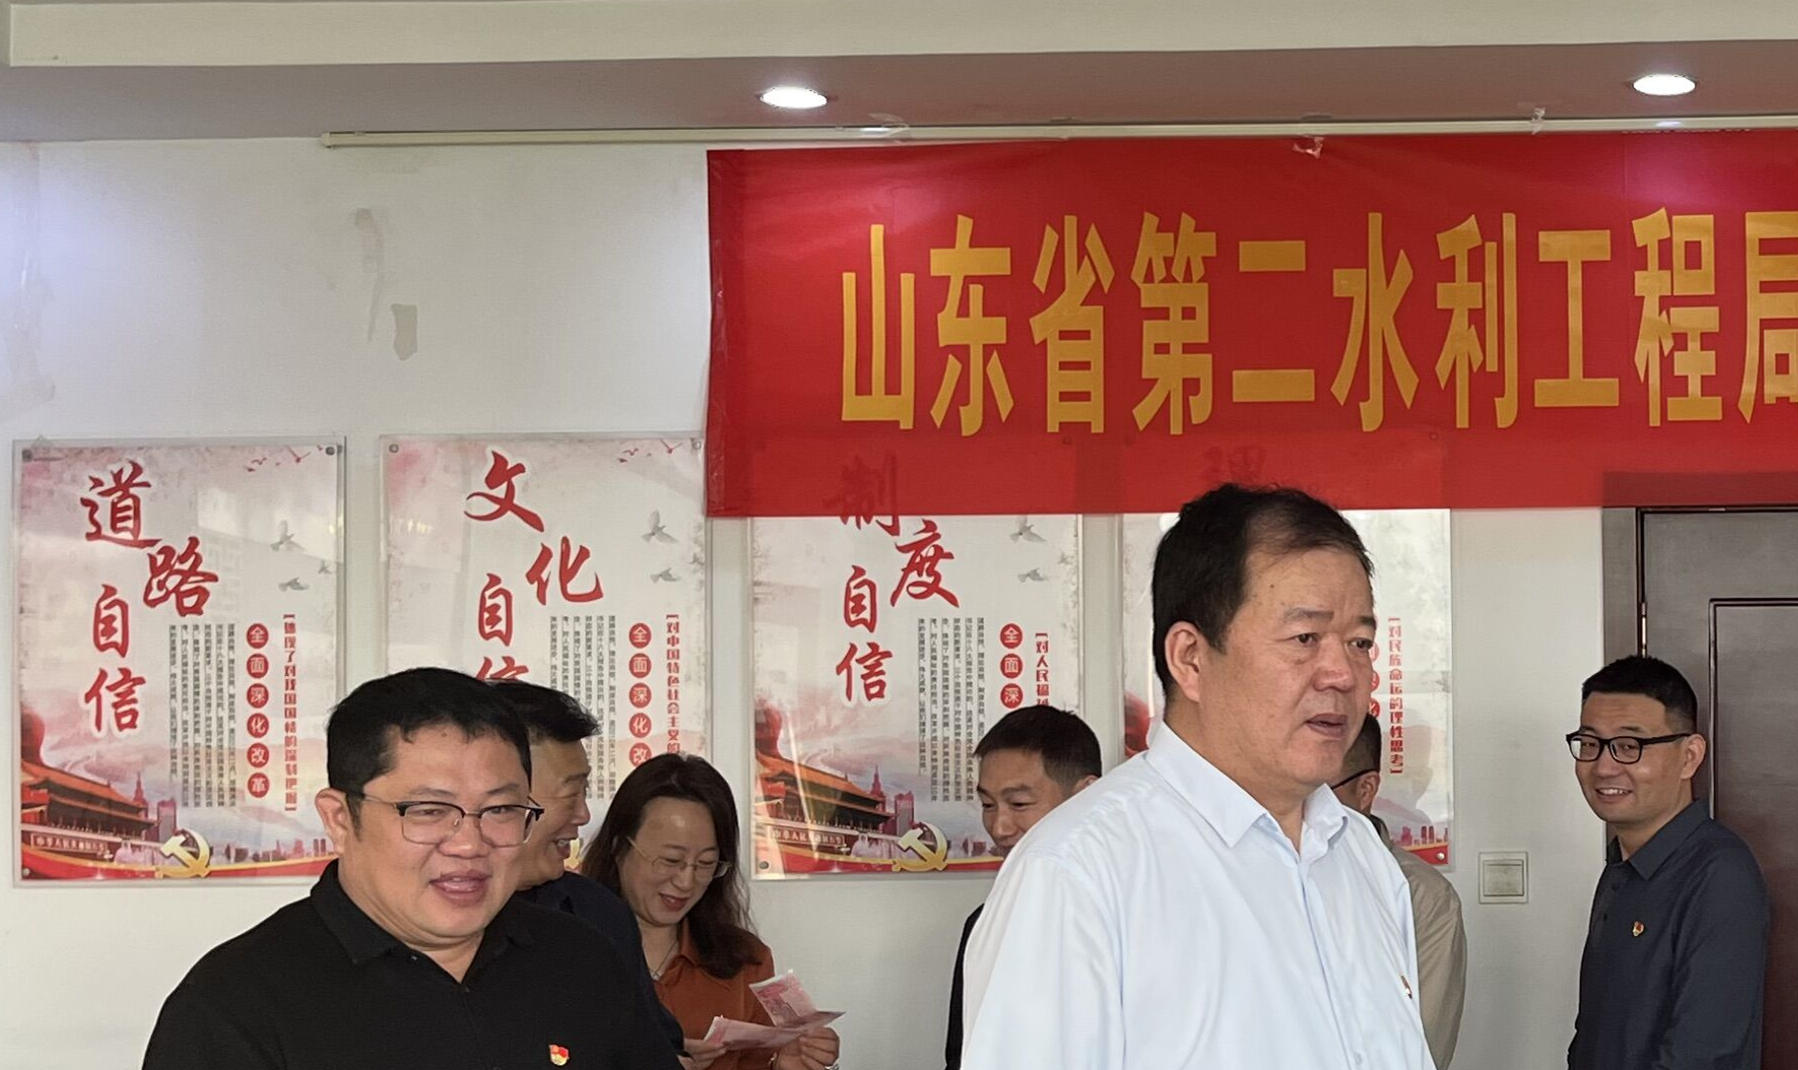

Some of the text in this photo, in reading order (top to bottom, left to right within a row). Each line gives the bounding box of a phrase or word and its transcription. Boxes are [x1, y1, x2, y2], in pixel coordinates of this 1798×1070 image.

[80, 462, 219, 617] 道路
[464, 450, 605, 605] 文化
[83, 582, 148, 732] 自信
[835, 564, 894, 702] 自信
[999, 622, 1024, 710] 全面深
[246, 623, 270, 799] 全面深化改革
